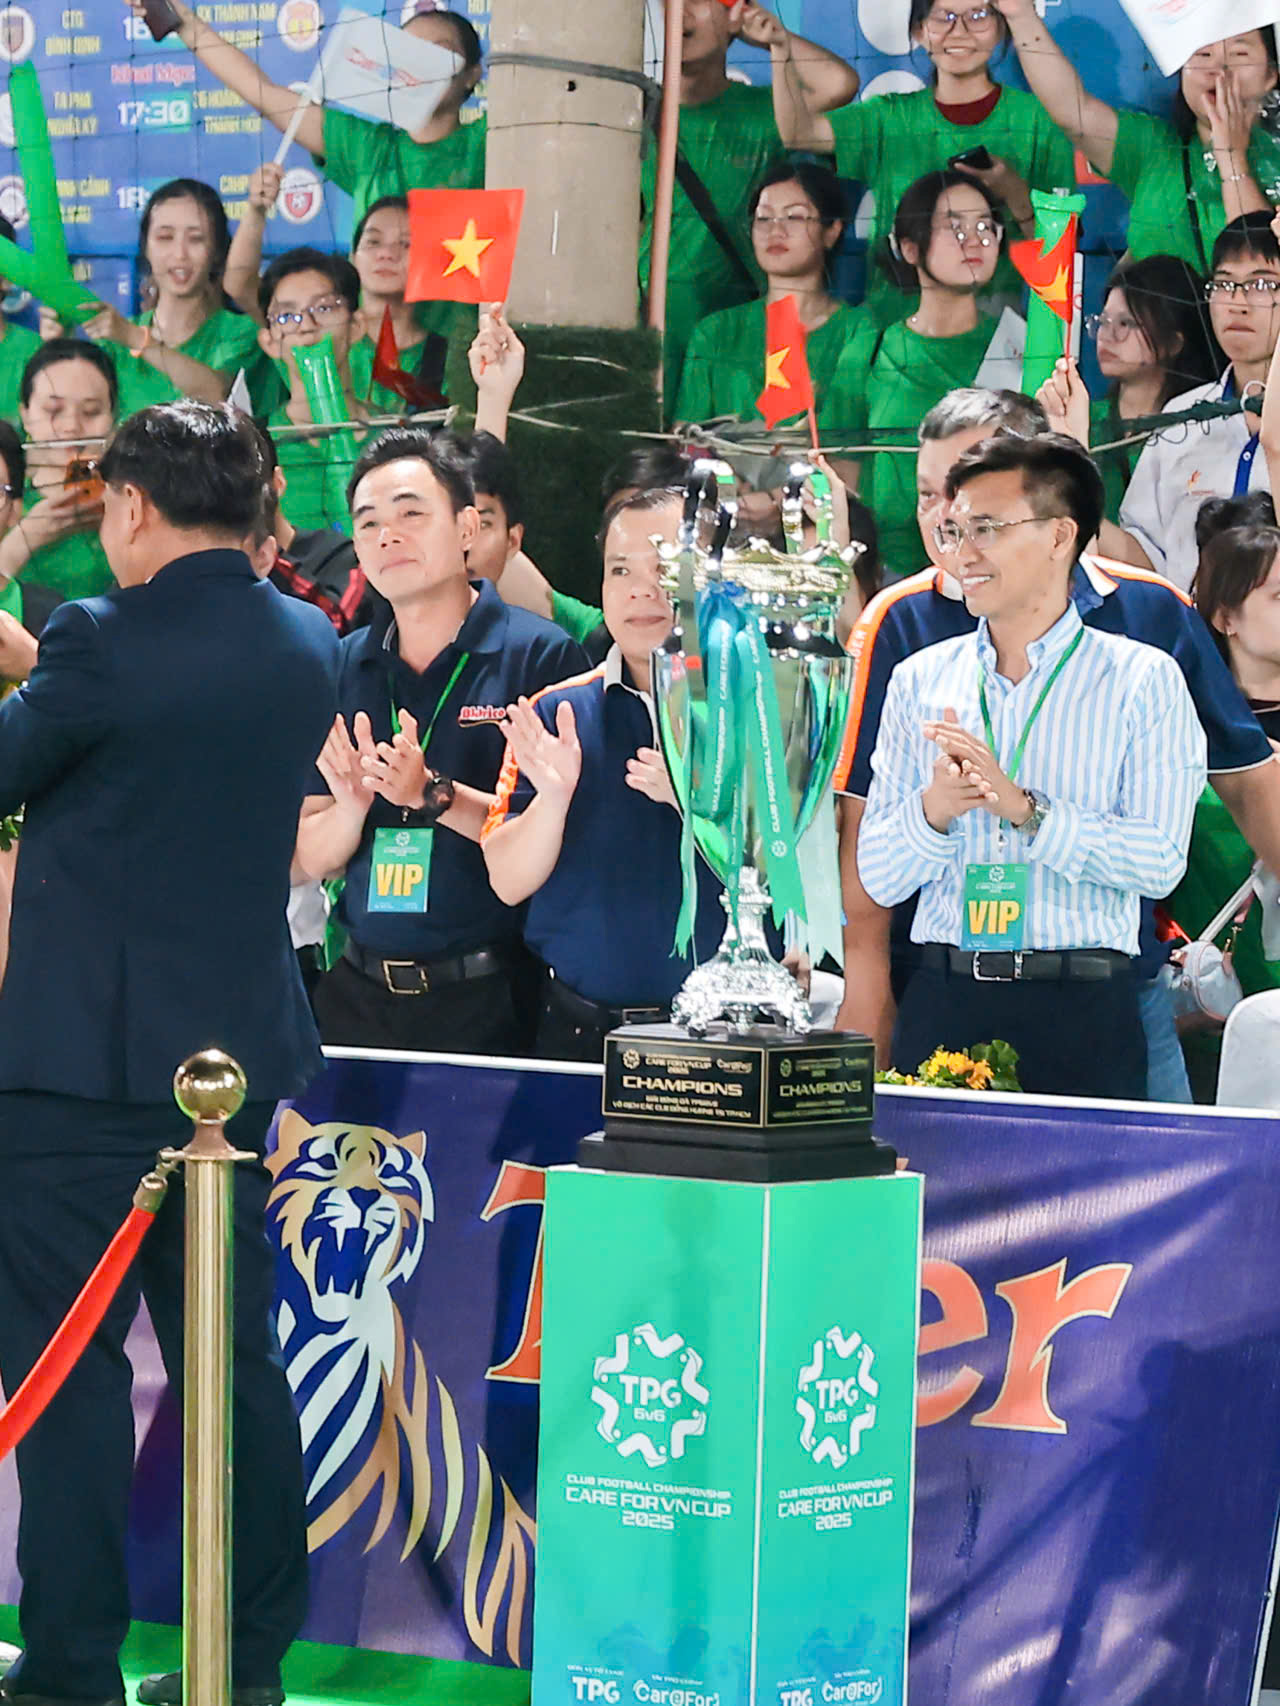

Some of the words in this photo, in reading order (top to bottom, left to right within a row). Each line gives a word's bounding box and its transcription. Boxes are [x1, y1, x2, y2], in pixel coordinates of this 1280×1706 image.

[118, 100, 190, 126] 17:30
[376, 863, 424, 896] VIP
[968, 900, 1020, 934] VIP
[622, 1075, 743, 1097] CHAMPIONS
[780, 1080, 862, 1097] CHAMPIONS
[619, 1374, 682, 1408] TPG
[815, 1377, 859, 1409] TPG
[566, 1473, 596, 1486] CLUB
[598, 1477, 651, 1493] FOOTBALL
[653, 1483, 732, 1500] CHAMPIONSHIP
[566, 1487, 617, 1507] CARE
[778, 1488, 798, 1499] CLUB
[799, 1484, 836, 1497] FOOTBALL
[836, 1477, 894, 1492] CHAMPIONSHIP
[622, 1509, 674, 1530] 2025
[778, 1499, 813, 1518] CARE
[815, 1511, 852, 1531] 2025
[572, 1676, 620, 1704] TPG
[780, 1688, 814, 1706] TPG
